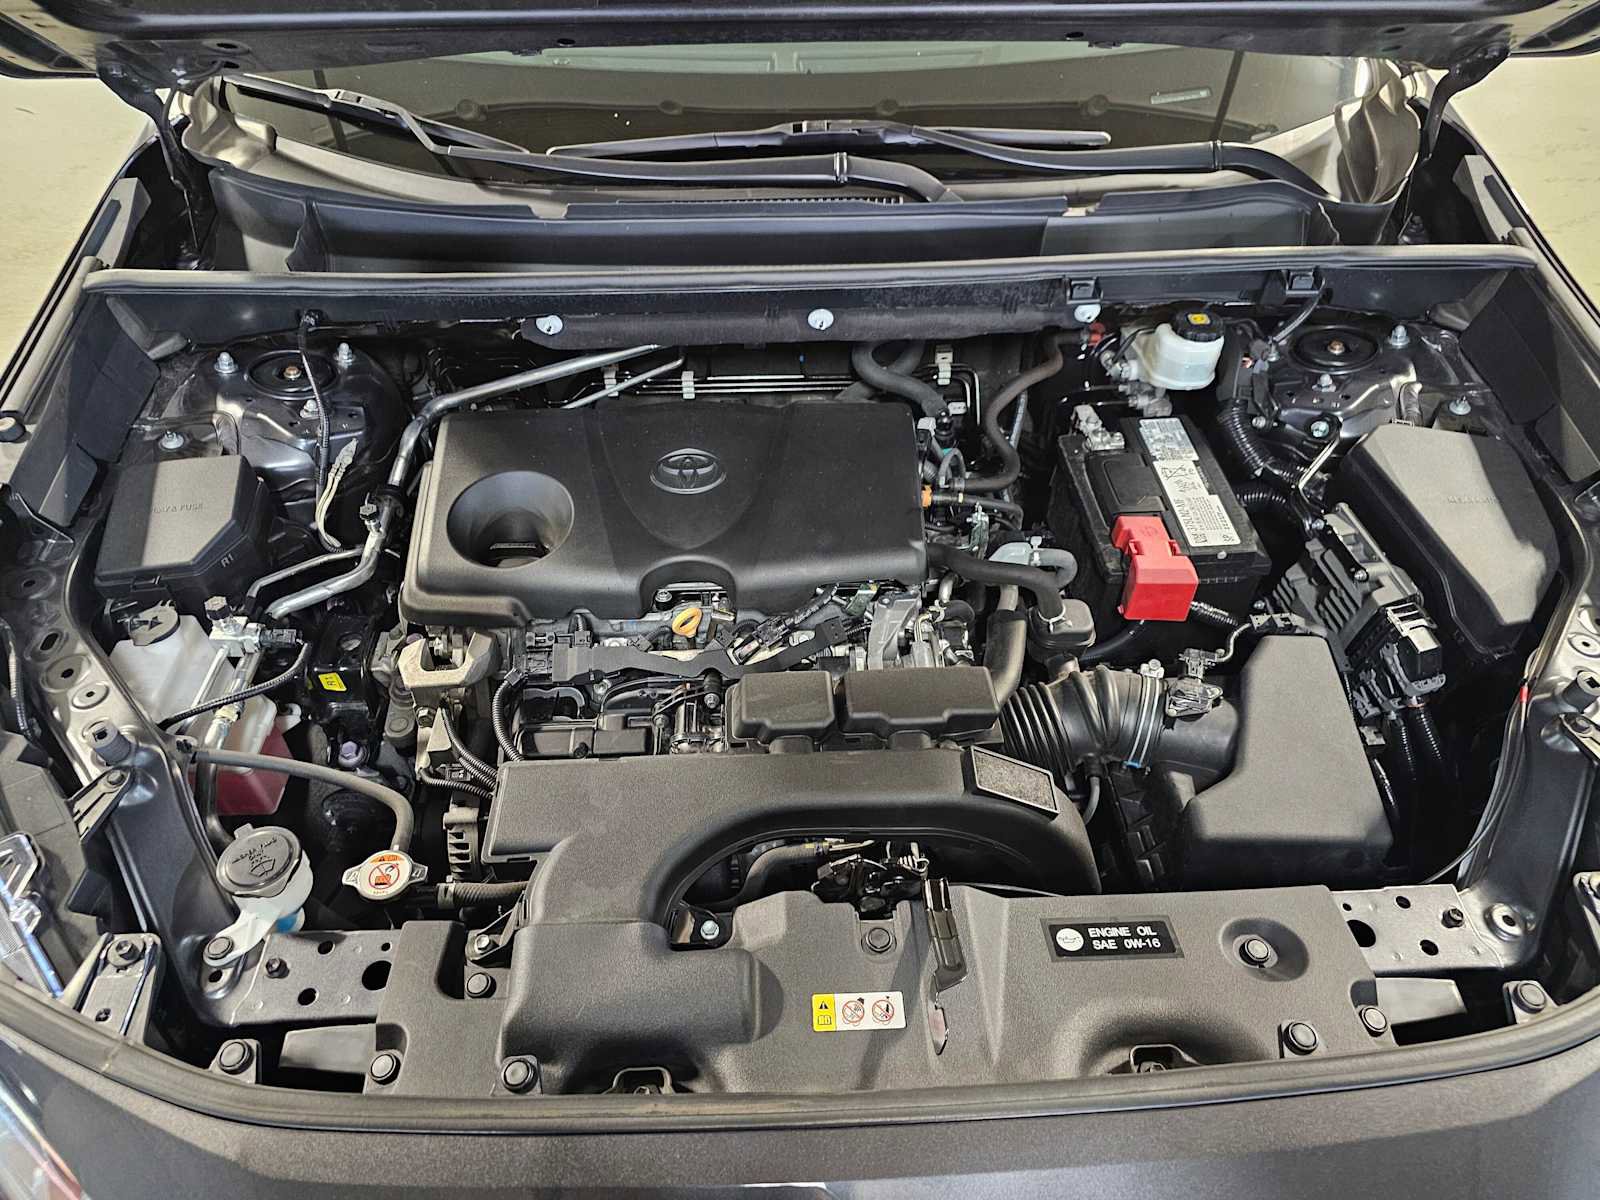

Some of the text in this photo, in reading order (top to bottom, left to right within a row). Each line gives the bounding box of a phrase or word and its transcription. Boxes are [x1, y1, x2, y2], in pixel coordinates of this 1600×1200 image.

[1088, 926, 1157, 938] ENGINE OIL
[1092, 938, 1161, 950] SAE 0W-16
